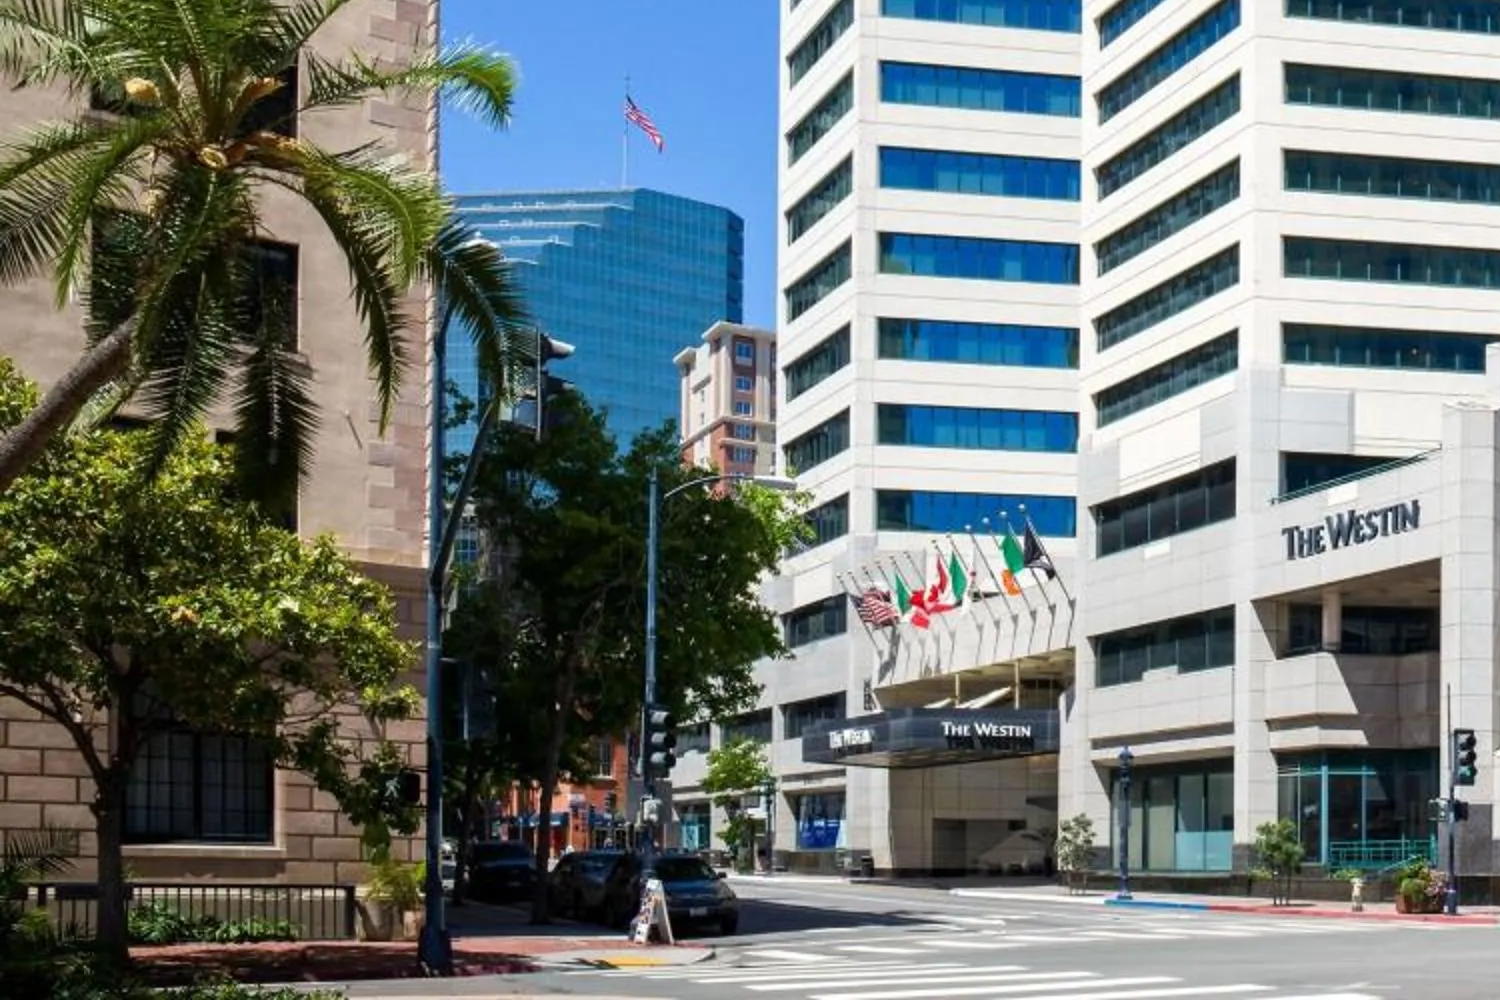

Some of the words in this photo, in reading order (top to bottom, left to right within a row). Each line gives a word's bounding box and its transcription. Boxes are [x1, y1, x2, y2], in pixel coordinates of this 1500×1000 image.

[1282, 526, 1326, 560] THE
[1325, 499, 1420, 549] WESTIN
[941, 721, 971, 737] THE
[974, 721, 1032, 737] WESTIN
